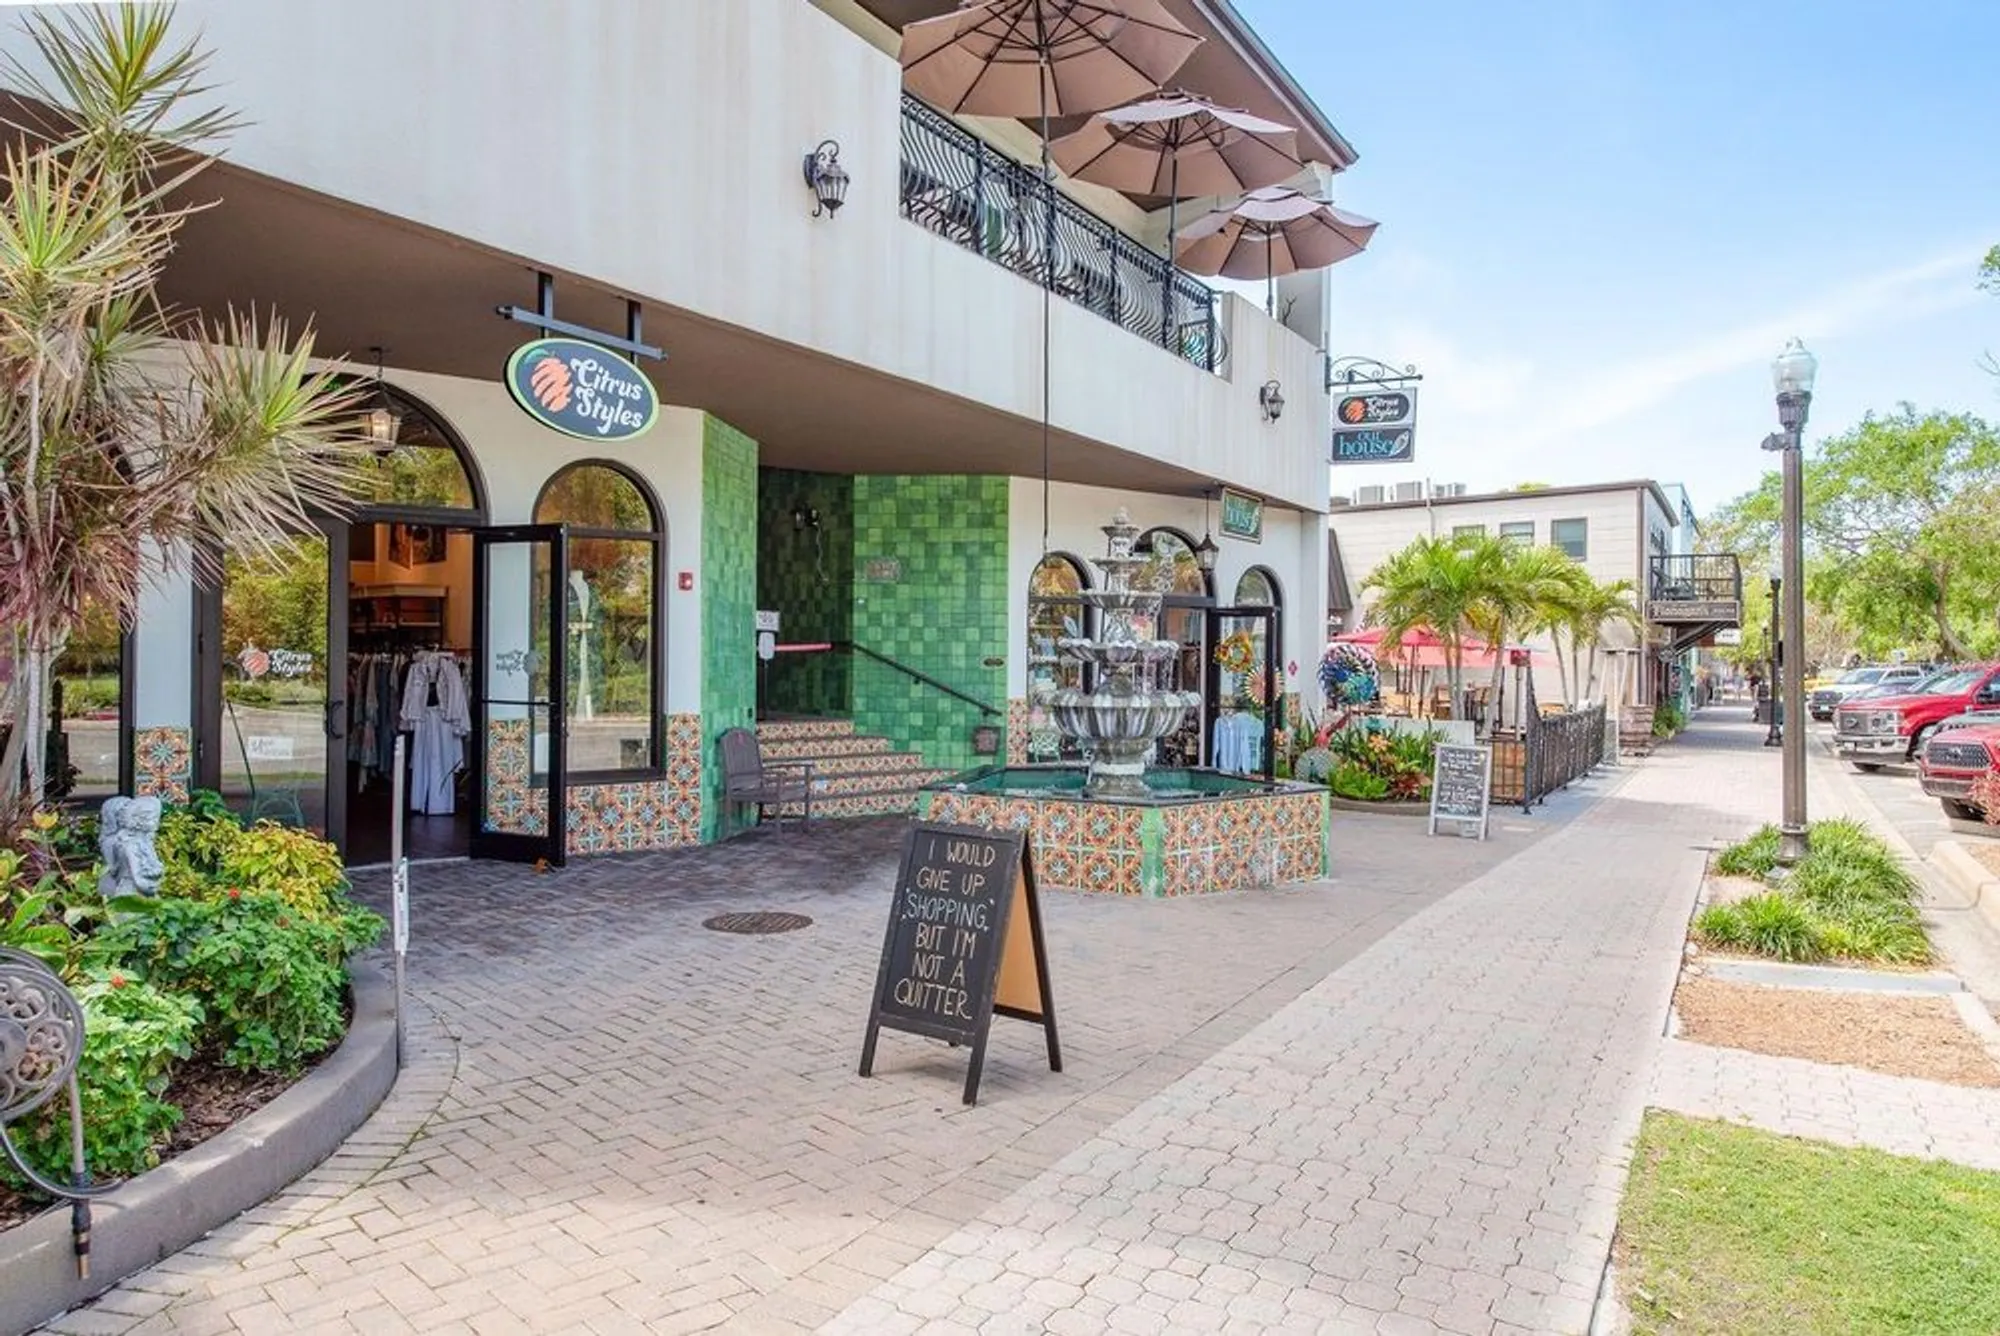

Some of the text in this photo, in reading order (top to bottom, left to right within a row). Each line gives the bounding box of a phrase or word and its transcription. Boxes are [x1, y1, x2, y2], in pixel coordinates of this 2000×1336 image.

[570, 358, 643, 400] Citrus
[575, 385, 643, 434] Styles
[1340, 435, 1395, 455] house
[928, 838, 996, 867] I WOULD
[916, 866, 986, 897] GIVE UP
[915, 922, 976, 960] BUT I'M
[912, 952, 965, 988] NOT A
[894, 977, 972, 1020] QUITTER
